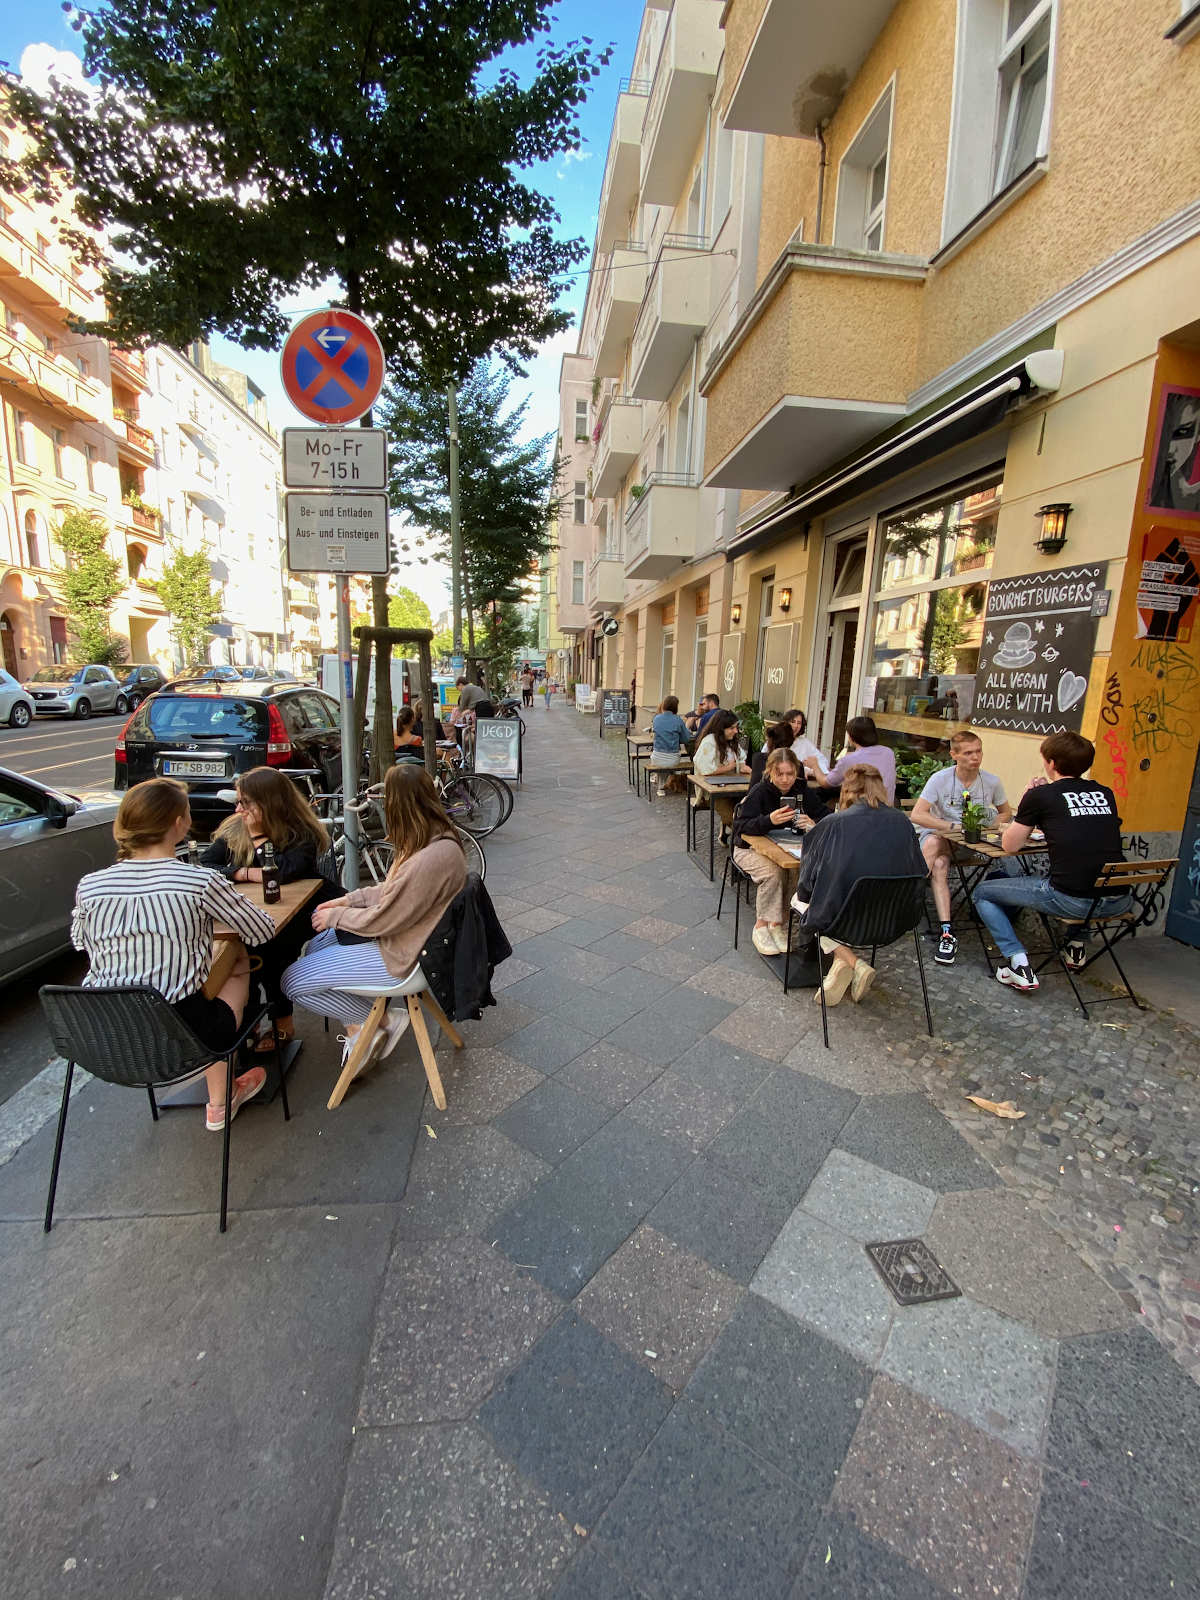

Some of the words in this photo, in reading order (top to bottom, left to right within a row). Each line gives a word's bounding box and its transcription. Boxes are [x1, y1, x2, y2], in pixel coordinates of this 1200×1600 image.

[305, 438, 363, 457] Mo-Fr
[310, 461, 347, 479] 7-15
[351, 462, 360, 480] h
[300, 506, 315, 517] Be-
[319, 507, 334, 517] und
[337, 507, 373, 518] Entladen
[296, 527, 315, 538] Aus-
[319, 528, 334, 538] und
[337, 528, 379, 542] Einsteigen
[1144, 562, 1184, 572] DEUTSCHLAND
[1140, 583, 1198, 594] #RASSISMUSPROBLEM
[985, 672, 1007, 688] ALL
[1010, 672, 1048, 690] VEGAN
[976, 693, 1013, 711] MADE
[1016, 693, 1054, 714] WITH
[170, 762, 183, 772] TF
[189, 763, 203, 773] SB
[205, 764, 224, 774] 982
[1069, 806, 1112, 817] BERLIN
